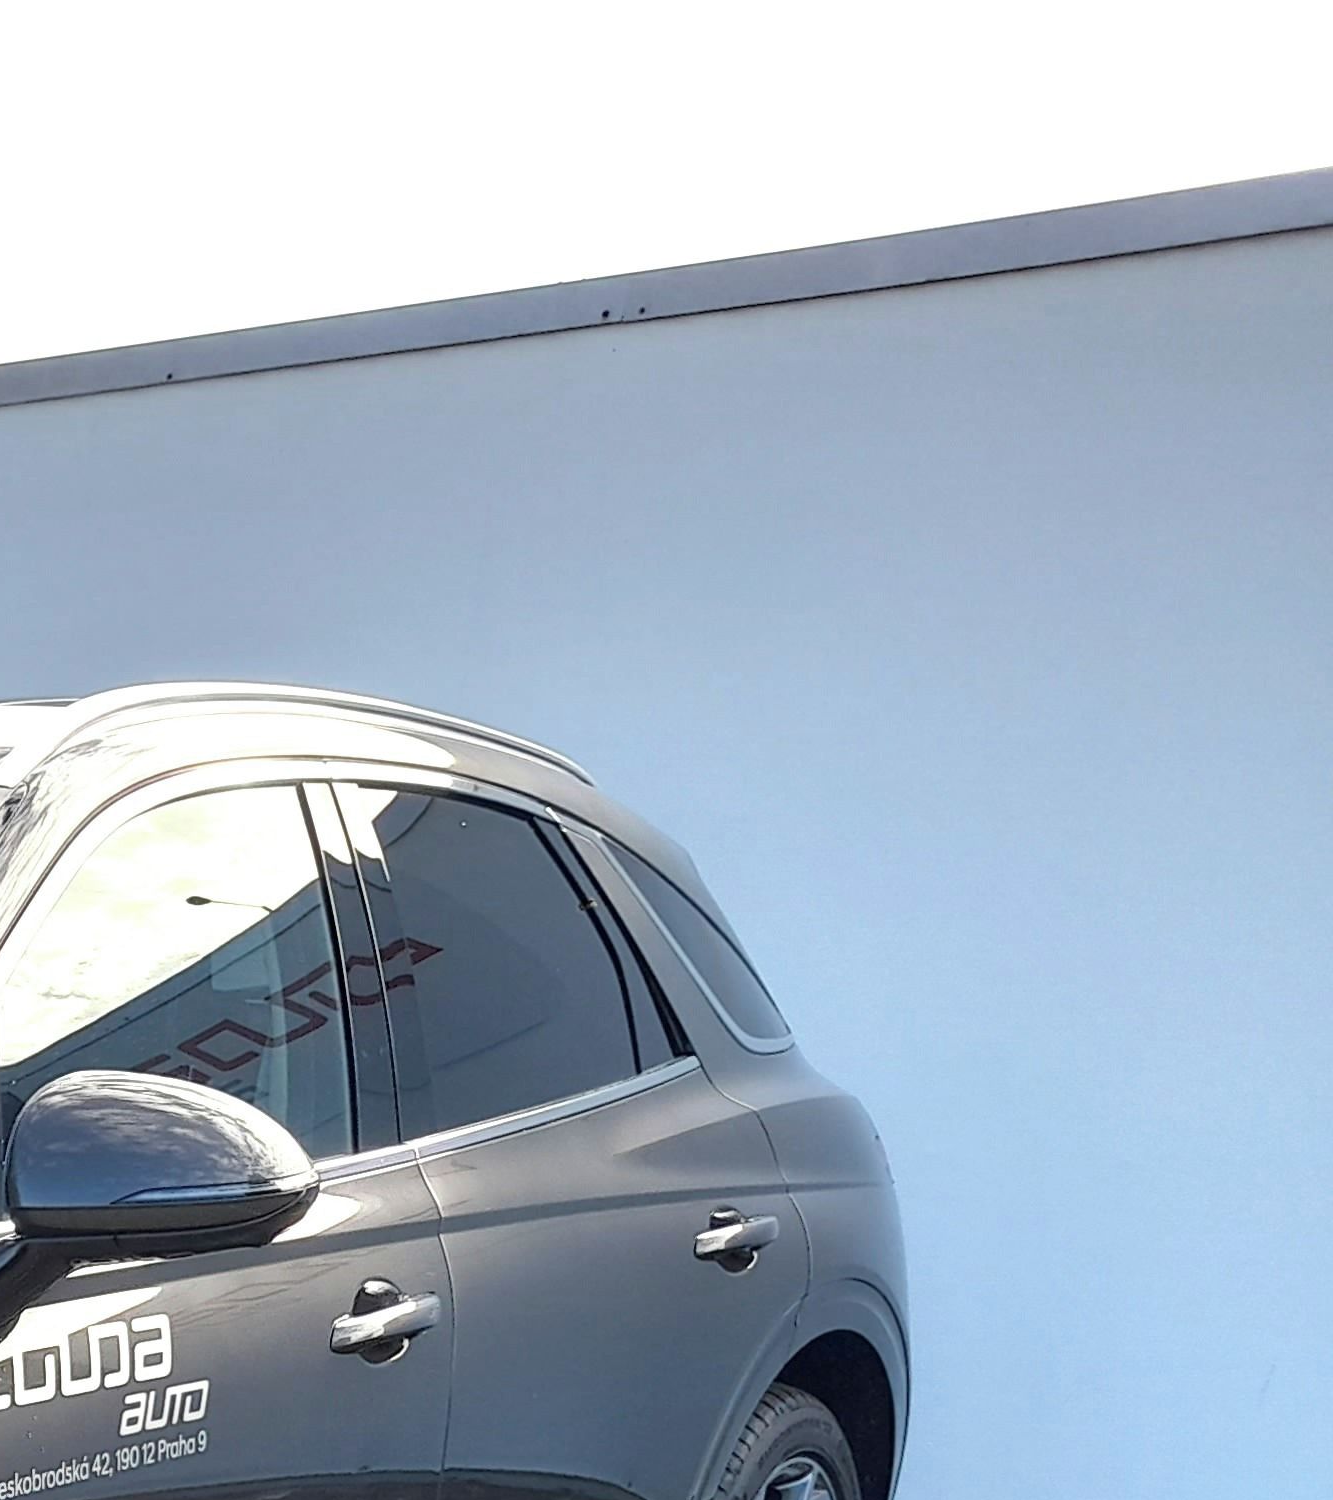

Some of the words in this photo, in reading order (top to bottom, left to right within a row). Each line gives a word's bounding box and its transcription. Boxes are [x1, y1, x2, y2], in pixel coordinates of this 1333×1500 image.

[91, 1452, 114, 1478] 42,
[115, 1446, 140, 1472] 190
[142, 1441, 156, 1465] 12
[157, 1434, 197, 1461] Praha
[197, 1429, 208, 1453] 9
